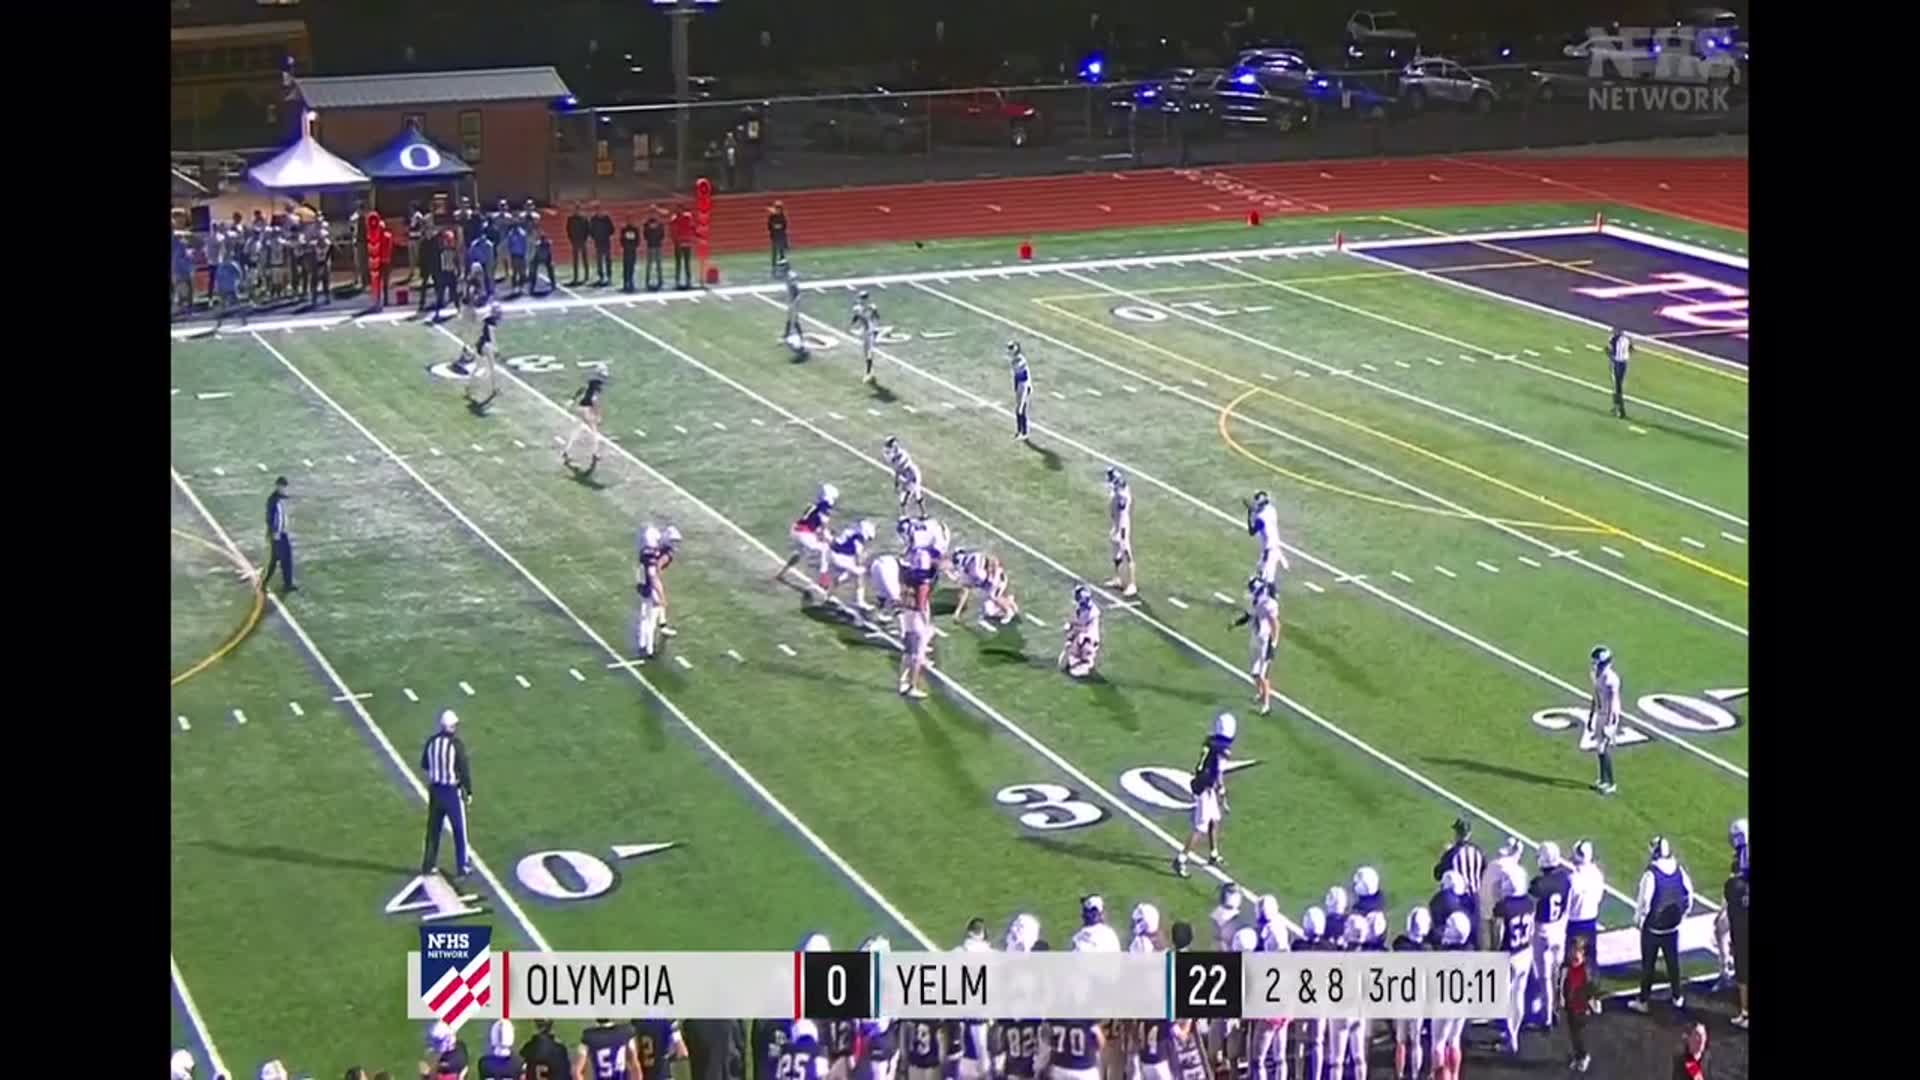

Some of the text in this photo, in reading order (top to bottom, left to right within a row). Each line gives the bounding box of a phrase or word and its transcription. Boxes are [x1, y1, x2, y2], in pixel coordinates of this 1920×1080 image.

[1532, 693, 1737, 751] 20
[995, 766, 1202, 829] 30
[384, 850, 615, 921] 40
[1052, 1026, 1086, 1057] 70
